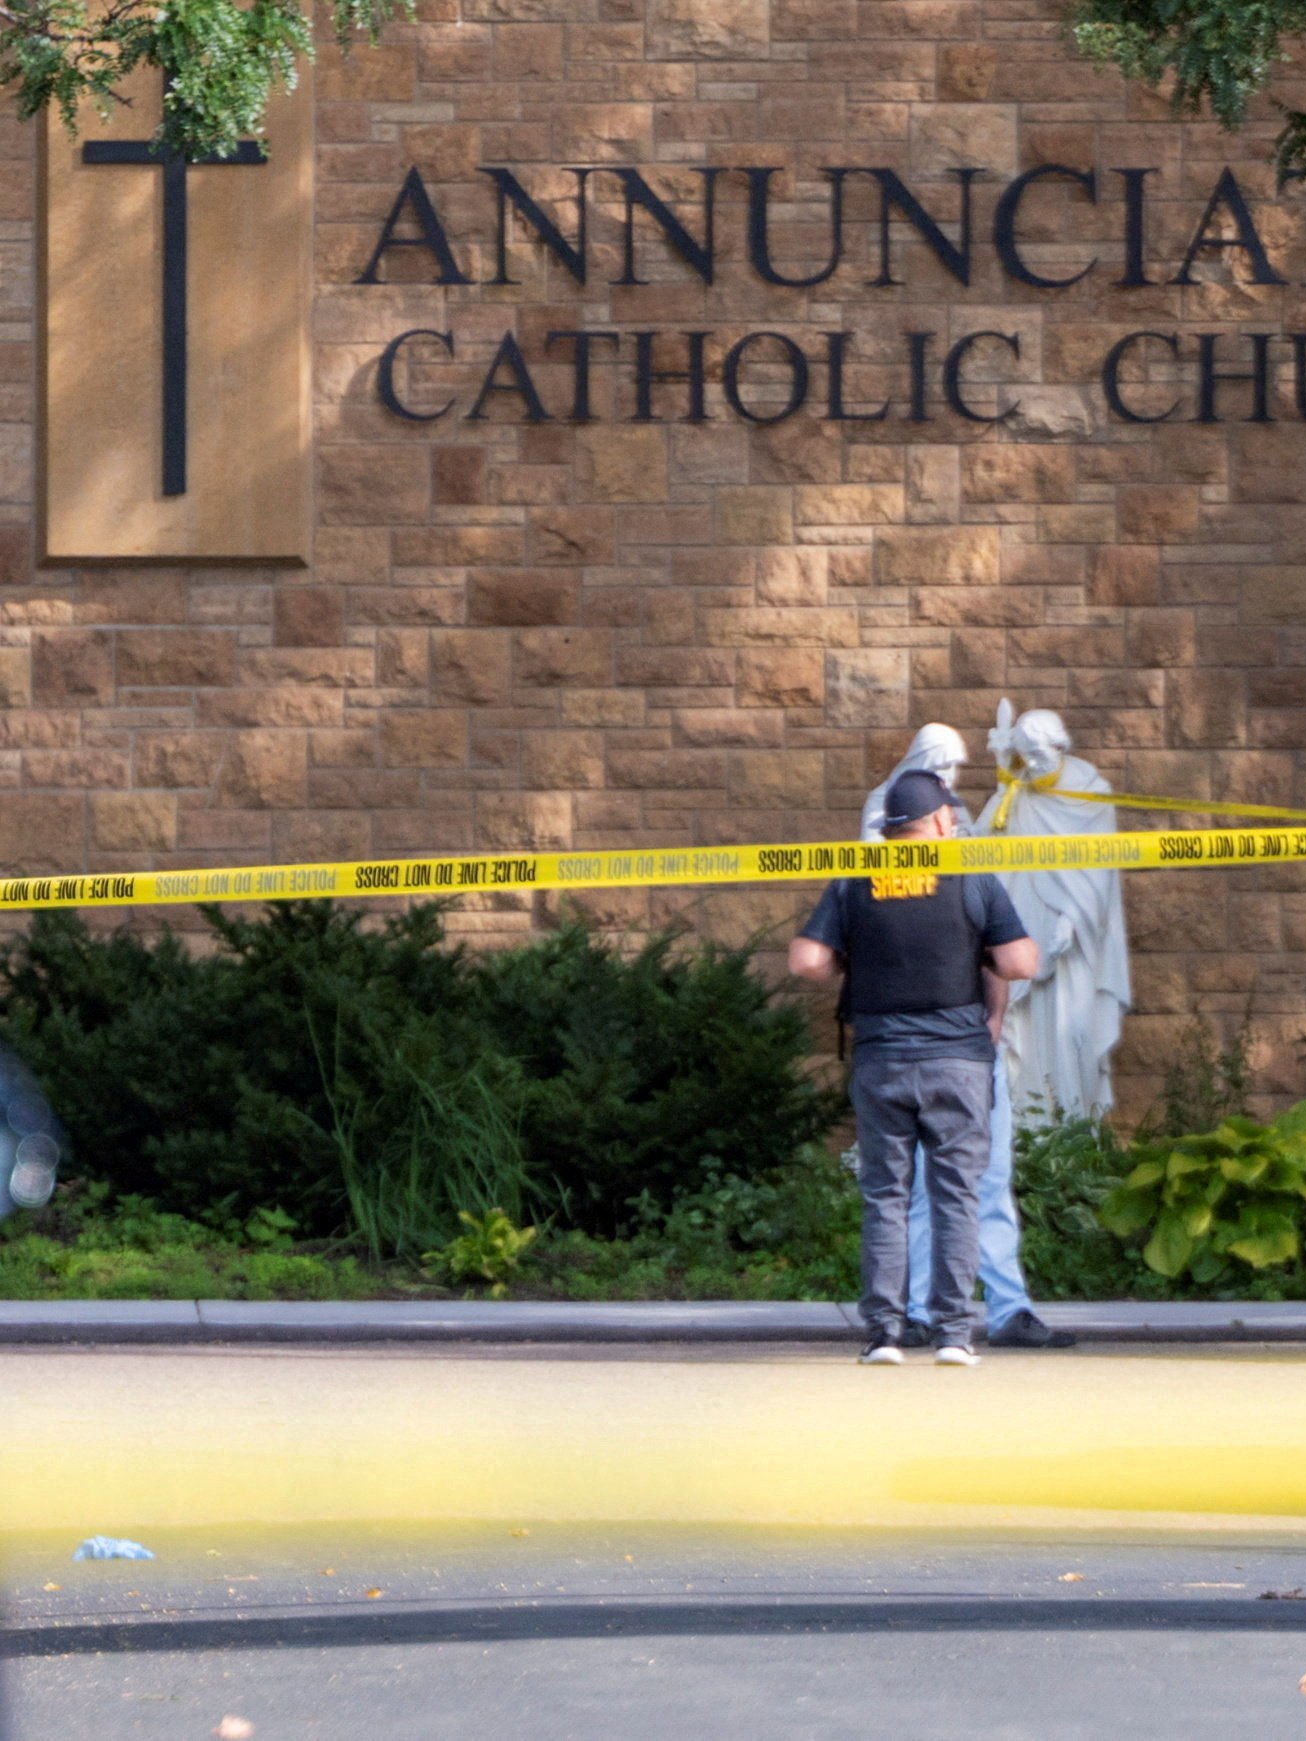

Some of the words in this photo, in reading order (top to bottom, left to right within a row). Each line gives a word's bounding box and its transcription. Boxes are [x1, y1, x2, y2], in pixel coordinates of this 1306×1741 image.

[376, 329, 1022, 424] CATHOLIC
[893, 844, 939, 868] POLICE
[960, 843, 1004, 867] CROSS
[1008, 842, 1033, 865] NOT
[1038, 841, 1056, 864] DO
[1061, 840, 1090, 863] LINE
[1094, 839, 1140, 862] POLICE
[1158, 836, 1202, 860] CROSS
[1206, 835, 1234, 858] NOT
[1238, 835, 1255, 858] DO
[1259, 834, 1288, 857] LINE
[557, 857, 601, 881] CROSS
[606, 856, 632, 879] NOT
[636, 855, 654, 878] DO
[660, 854, 688, 877] LINE
[692, 852, 739, 875] POLICE
[758, 849, 801, 872] CROSS
[806, 848, 834, 870] NOT
[838, 847, 855, 870] DO
[860, 846, 888, 869] LINE
[256, 871, 285, 893] LINE
[289, 868, 337, 891] POLICE
[355, 865, 399, 888] CROSS
[403, 864, 431, 887] NOT
[435, 862, 453, 885] DO
[457, 861, 487, 884] LINE
[491, 859, 537, 883] POLICE
[2, 882, 29, 901] NOT
[33, 880, 50, 900] DO
[55, 879, 85, 900] LINE
[89, 877, 135, 898] POLICE
[155, 875, 199, 897] CROSS
[203, 873, 229, 895] NOT
[234, 872, 252, 894] DO
[871, 874, 939, 901] SHERIFF
